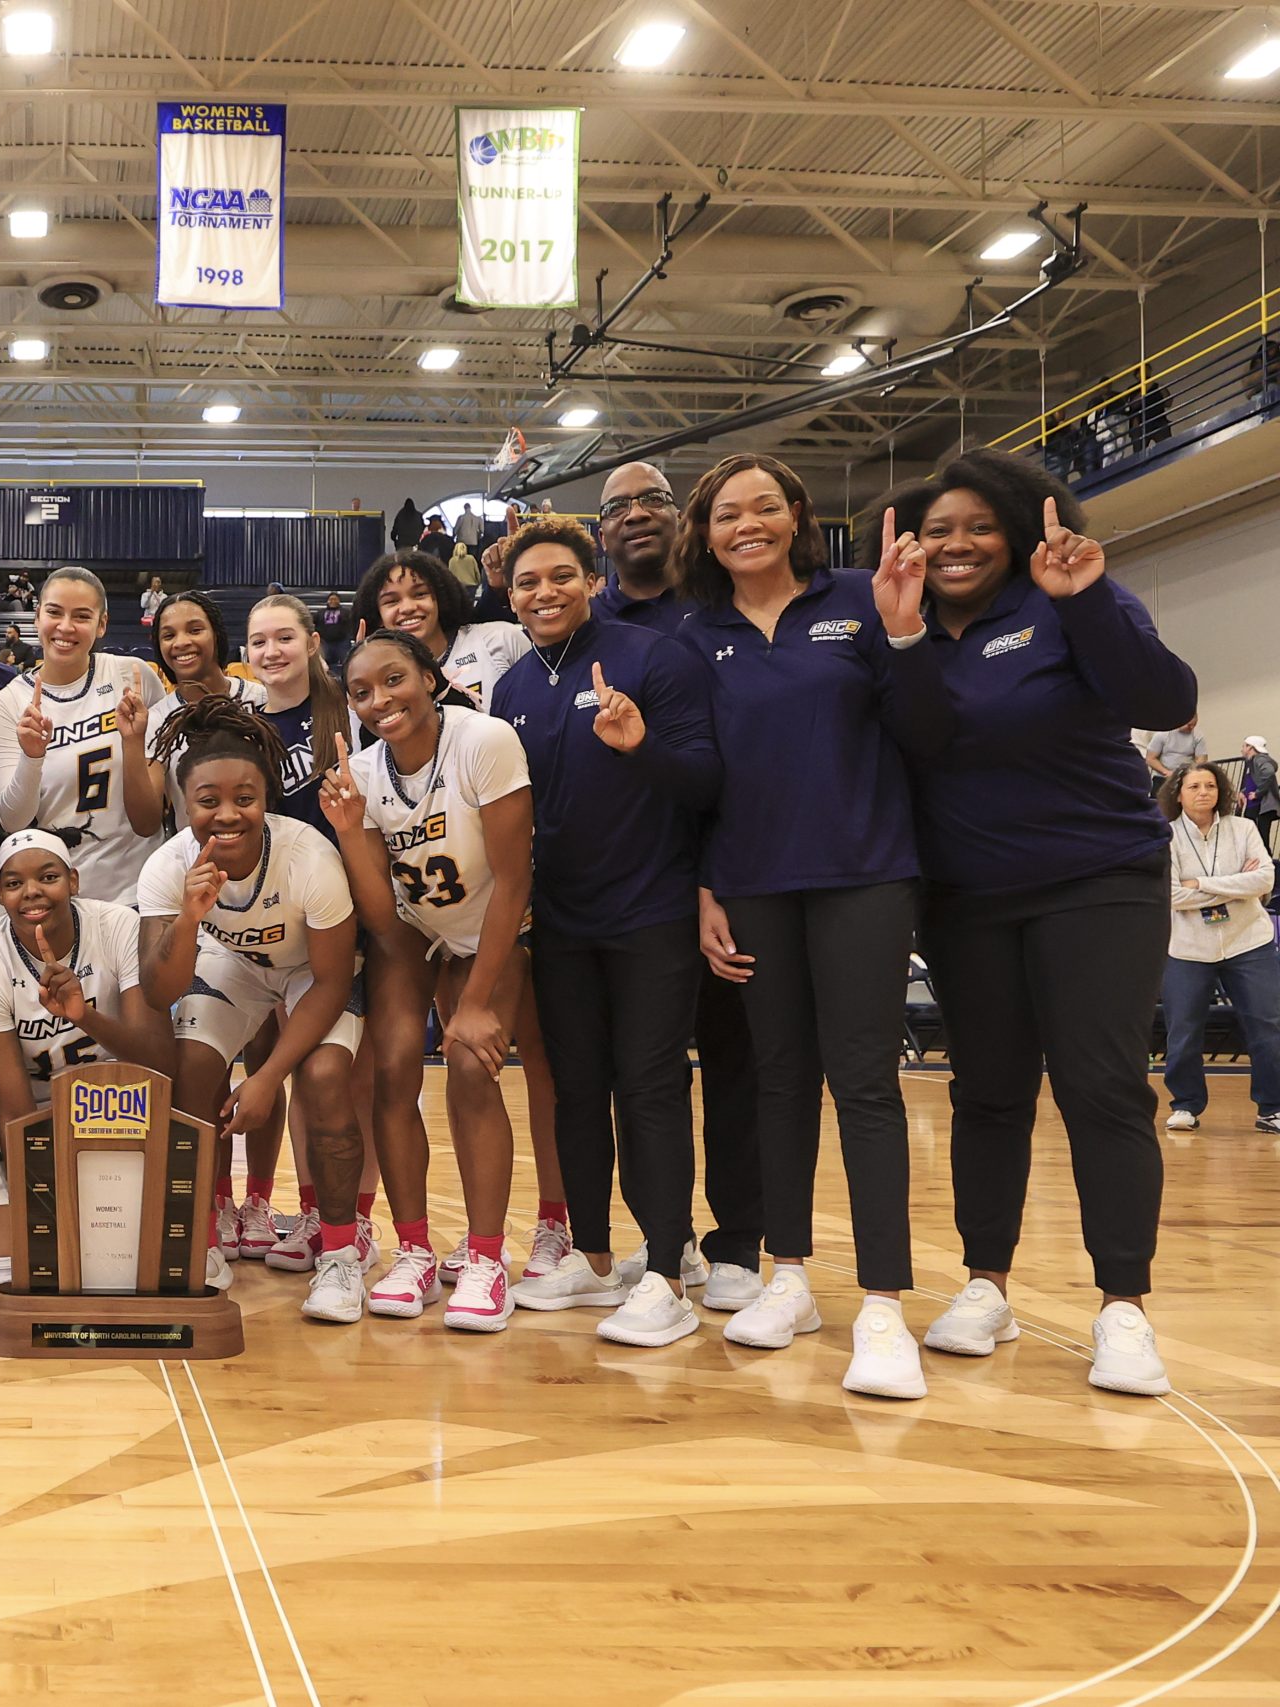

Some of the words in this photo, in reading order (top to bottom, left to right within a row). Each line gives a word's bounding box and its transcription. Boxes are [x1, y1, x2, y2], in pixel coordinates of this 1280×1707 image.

[180, 105, 264, 118] WOMEN'S
[172, 118, 271, 132] BASKETBALL
[170, 187, 247, 211] NCAA
[467, 184, 563, 200] RUNNER-UP
[170, 211, 273, 230] TOURNAMENT
[480, 238, 555, 263] 2017
[196, 266, 244, 286] 1998
[30, 495, 71, 503] SECTION
[41, 503, 60, 520] 2
[808, 619, 863, 636] UNCG
[982, 625, 1036, 656] UNCG
[454, 652, 478, 668] SOCON
[76, 744, 113, 813] 6
[43, 1331, 79, 1340] UNIVERSITY
[80, 1331, 89, 1340] OF
[89, 1331, 111, 1340] NORTH
[110, 1332, 141, 1341] CAROLINA
